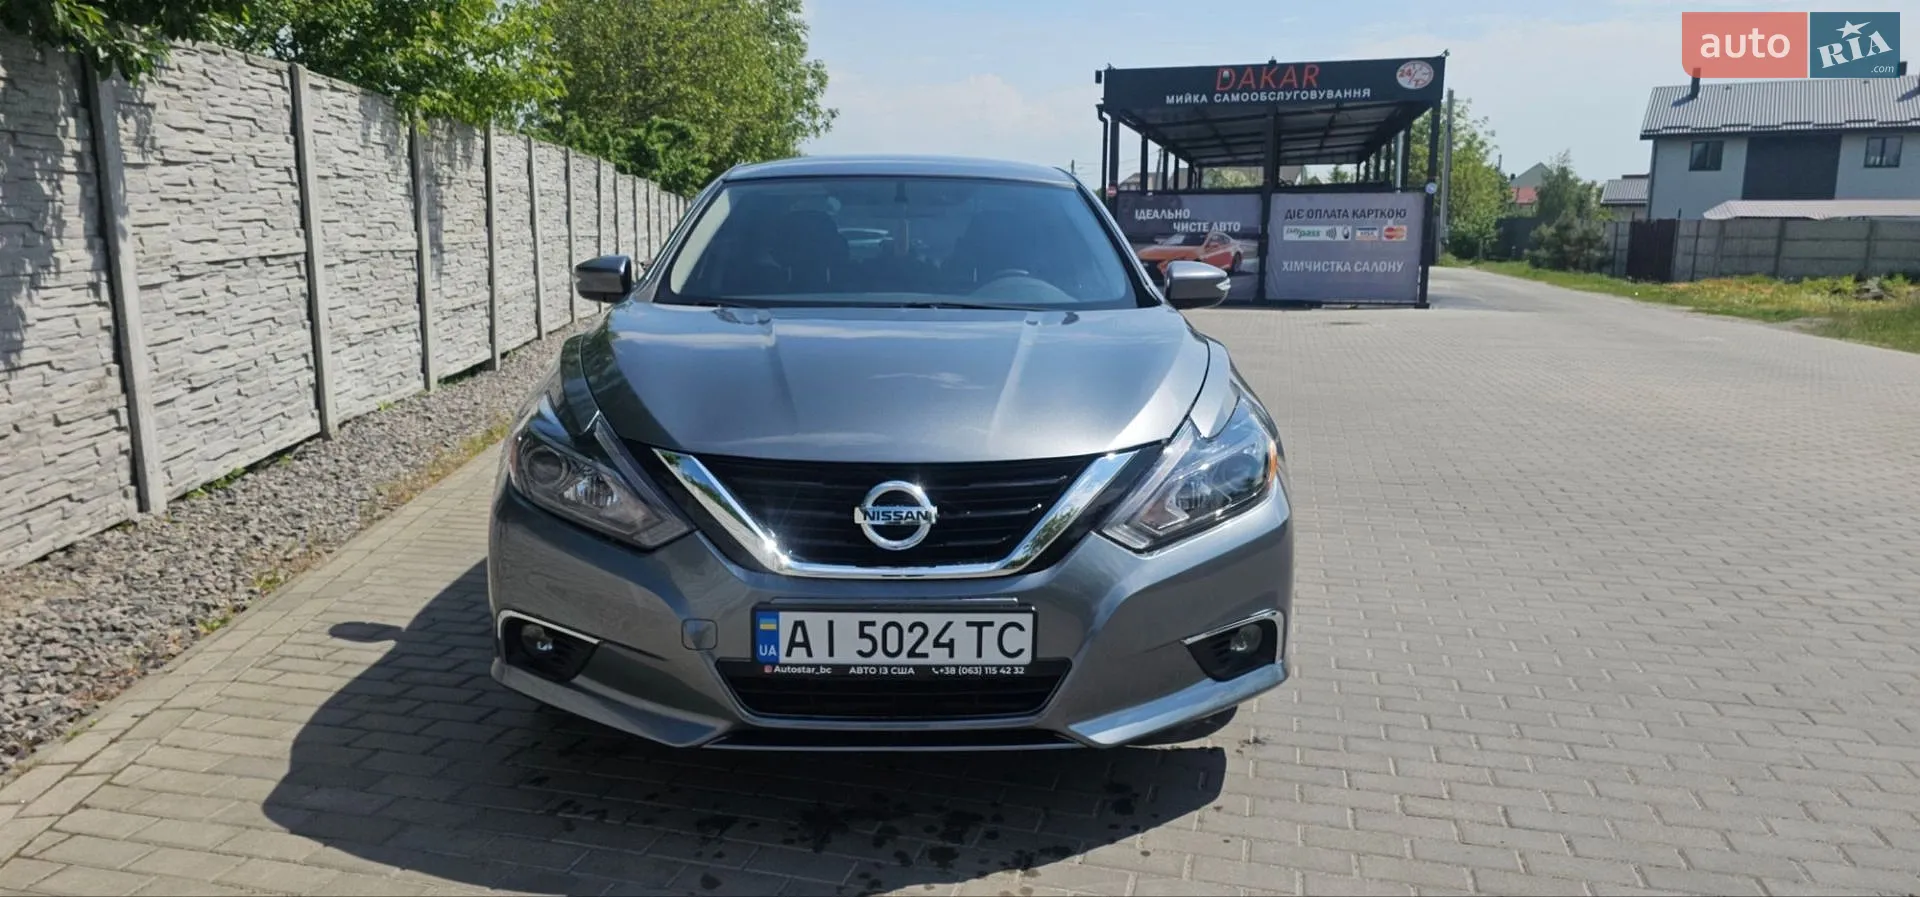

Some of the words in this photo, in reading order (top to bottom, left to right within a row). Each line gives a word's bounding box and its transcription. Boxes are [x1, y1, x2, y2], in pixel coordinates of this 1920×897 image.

[1215, 64, 1320, 91] DAKAR
[1166, 92, 1208, 105] МИЙКА
[1213, 87, 1371, 103] САМООБСЛУГОВУВАННЯ
[1134, 208, 1190, 220] ІДЕАЛЬНО
[1284, 209, 1304, 220] ДІЄ
[1306, 208, 1349, 219] ОПЛАТА
[1352, 208, 1407, 219] КАРТКОЮ
[1173, 222, 1209, 233] ЧИСТЕ
[1211, 222, 1241, 233] АВТО
[1282, 261, 1350, 273] ХІМЧИСТКА
[1354, 261, 1405, 273] САЛОНУ
[864, 509, 928, 521] NISSAN
[856, 620, 955, 659] 5024
[966, 620, 1026, 659] TC
[759, 645, 777, 657] UA
[774, 665, 832, 675] Autostar_bc
[849, 666, 876, 675] АВТО
[891, 667, 915, 675] США
[939, 667, 956, 675] +38
[958, 666, 982, 676] (063)
[985, 667, 997, 675] 115
[1000, 667, 1011, 675] 42
[1013, 667, 1025, 675] 32
